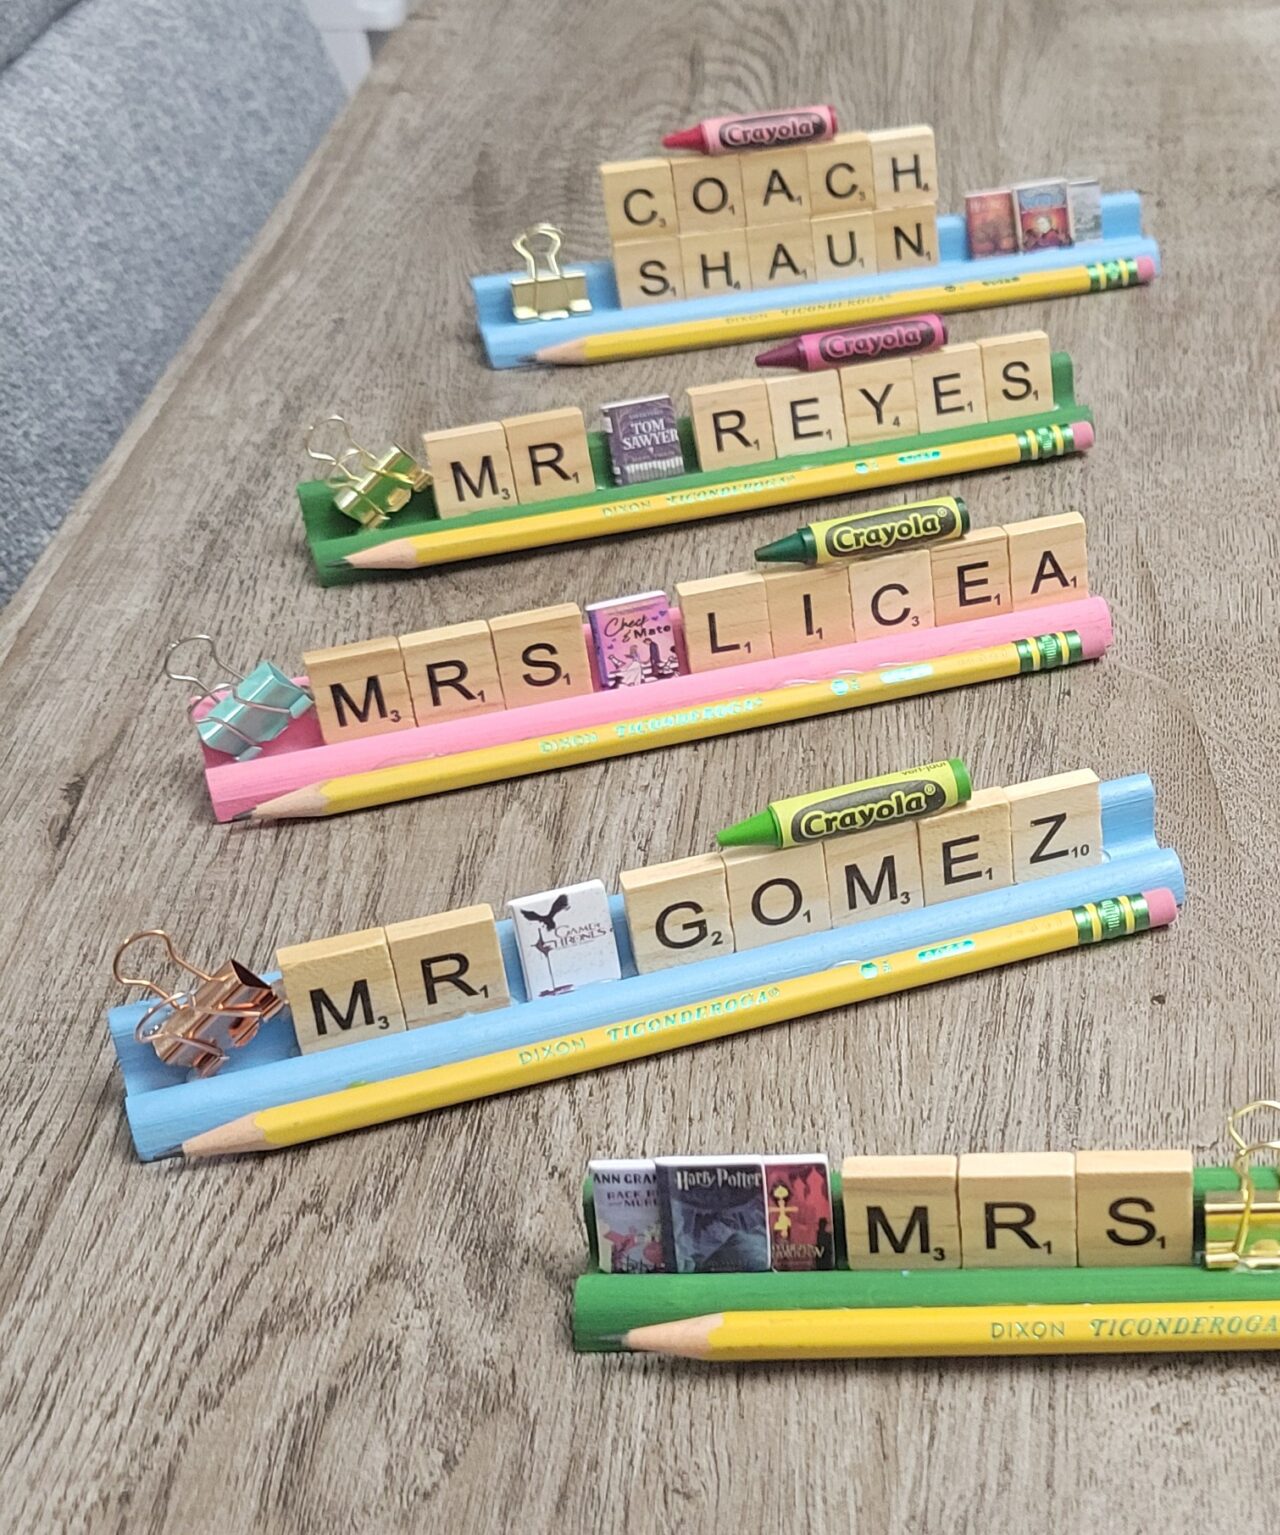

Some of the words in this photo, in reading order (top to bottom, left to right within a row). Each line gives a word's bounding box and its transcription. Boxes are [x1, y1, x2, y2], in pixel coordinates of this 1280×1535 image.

[623, 154, 922, 226] COACH
[639, 222, 923, 296] SHAUN
[450, 442, 571, 501] MR
[712, 361, 1034, 452] REYES
[622, 428, 679, 450] SAWYER
[630, 418, 665, 434] TOM
[330, 643, 562, 727] MRS
[708, 551, 1070, 653] LICEA
[309, 952, 478, 1036] MR
[655, 812, 1068, 949] GOMEZ
[518, 1037, 586, 1065] DIXON
[594, 1173, 620, 1184] ANN
[676, 1170, 715, 1190] Harry
[717, 1168, 762, 1188] Potter
[867, 1197, 1157, 1254] MRS
[991, 1321, 1065, 1339] DIXON
